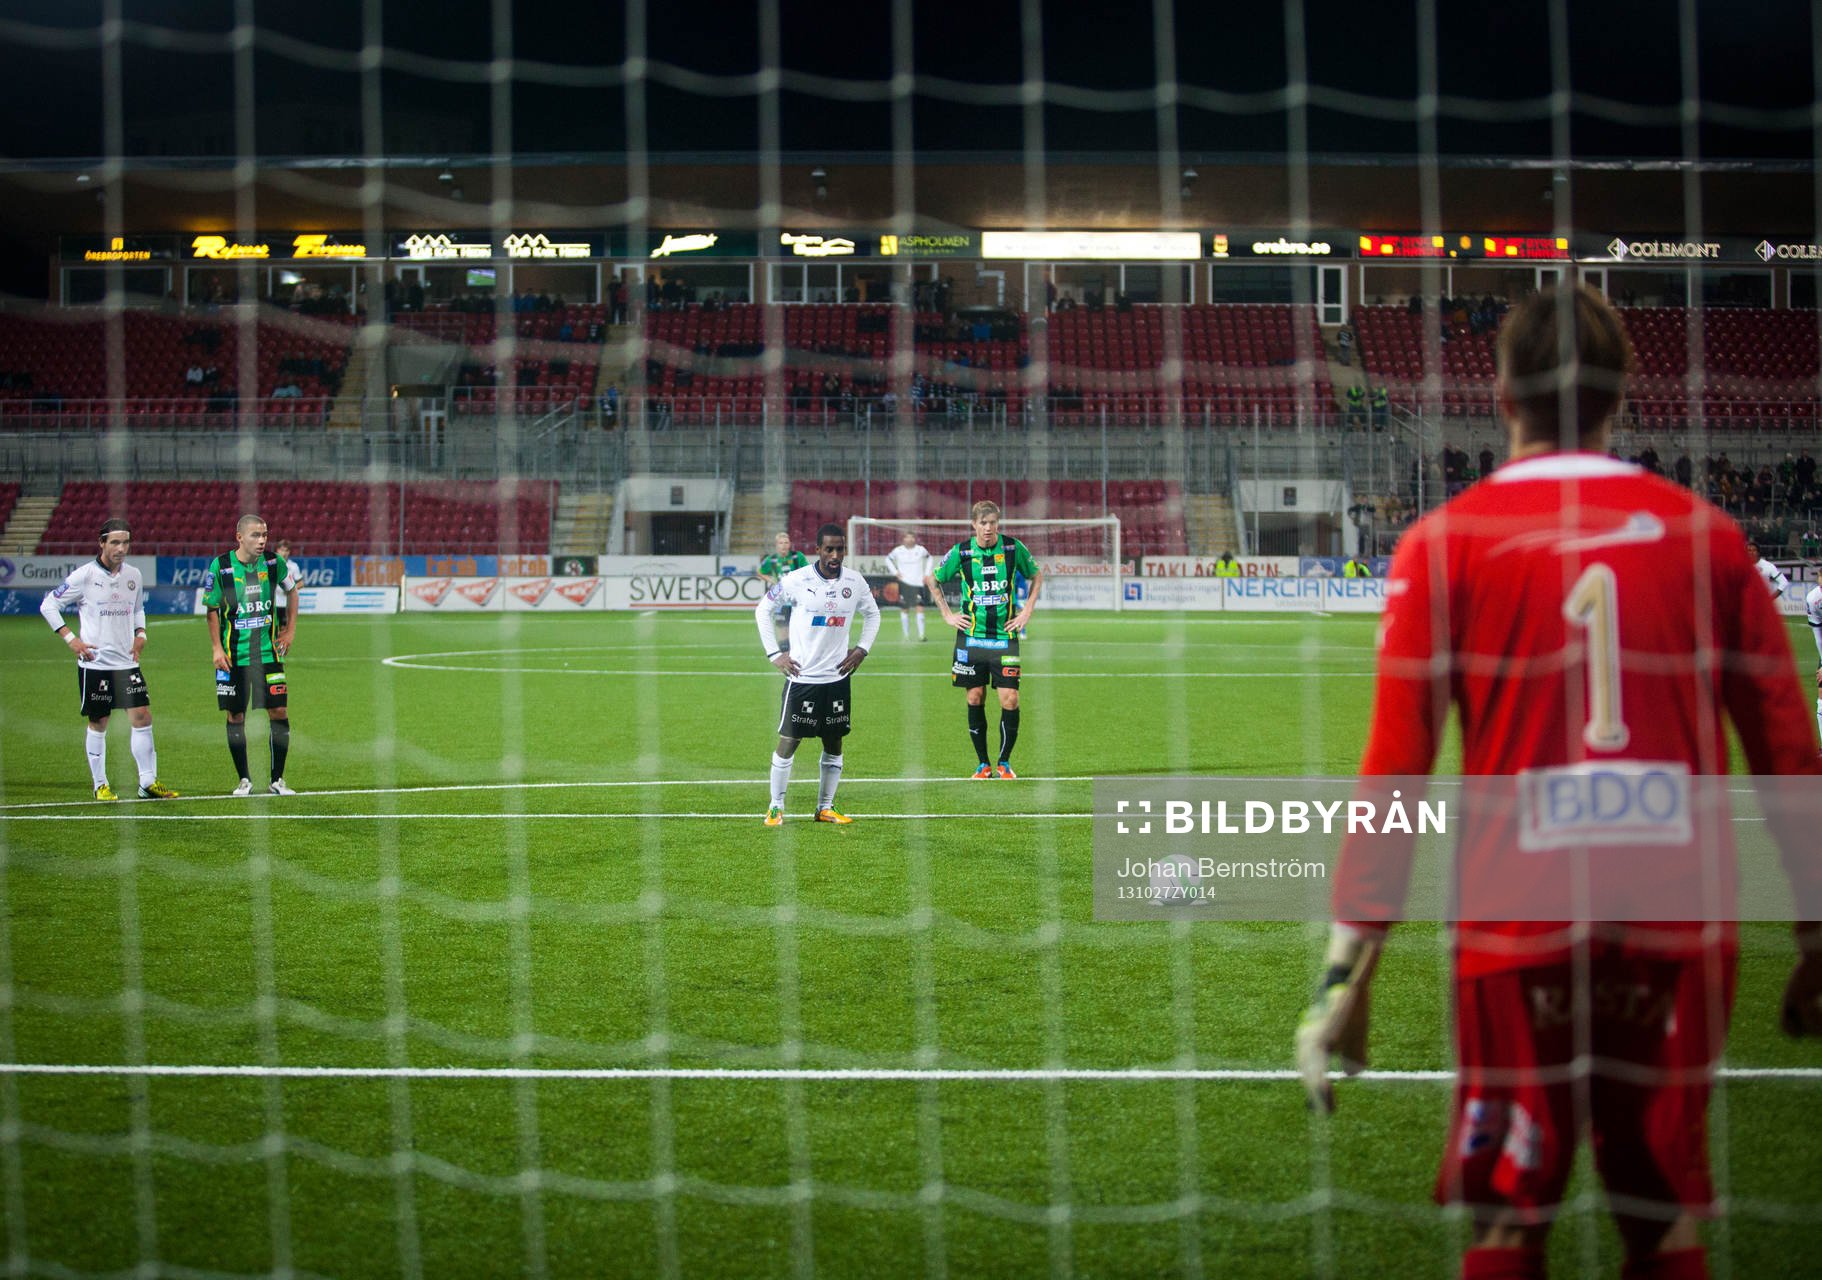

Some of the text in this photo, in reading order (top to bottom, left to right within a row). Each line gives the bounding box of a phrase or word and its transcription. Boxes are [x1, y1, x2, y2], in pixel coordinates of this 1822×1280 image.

[1629, 242, 1721, 258] COLEMONT
[22, 563, 62, 579] Grant
[1227, 578, 1320, 598] NERCIA
[1562, 562, 1630, 752] 1
[1547, 770, 1680, 826] BDO
